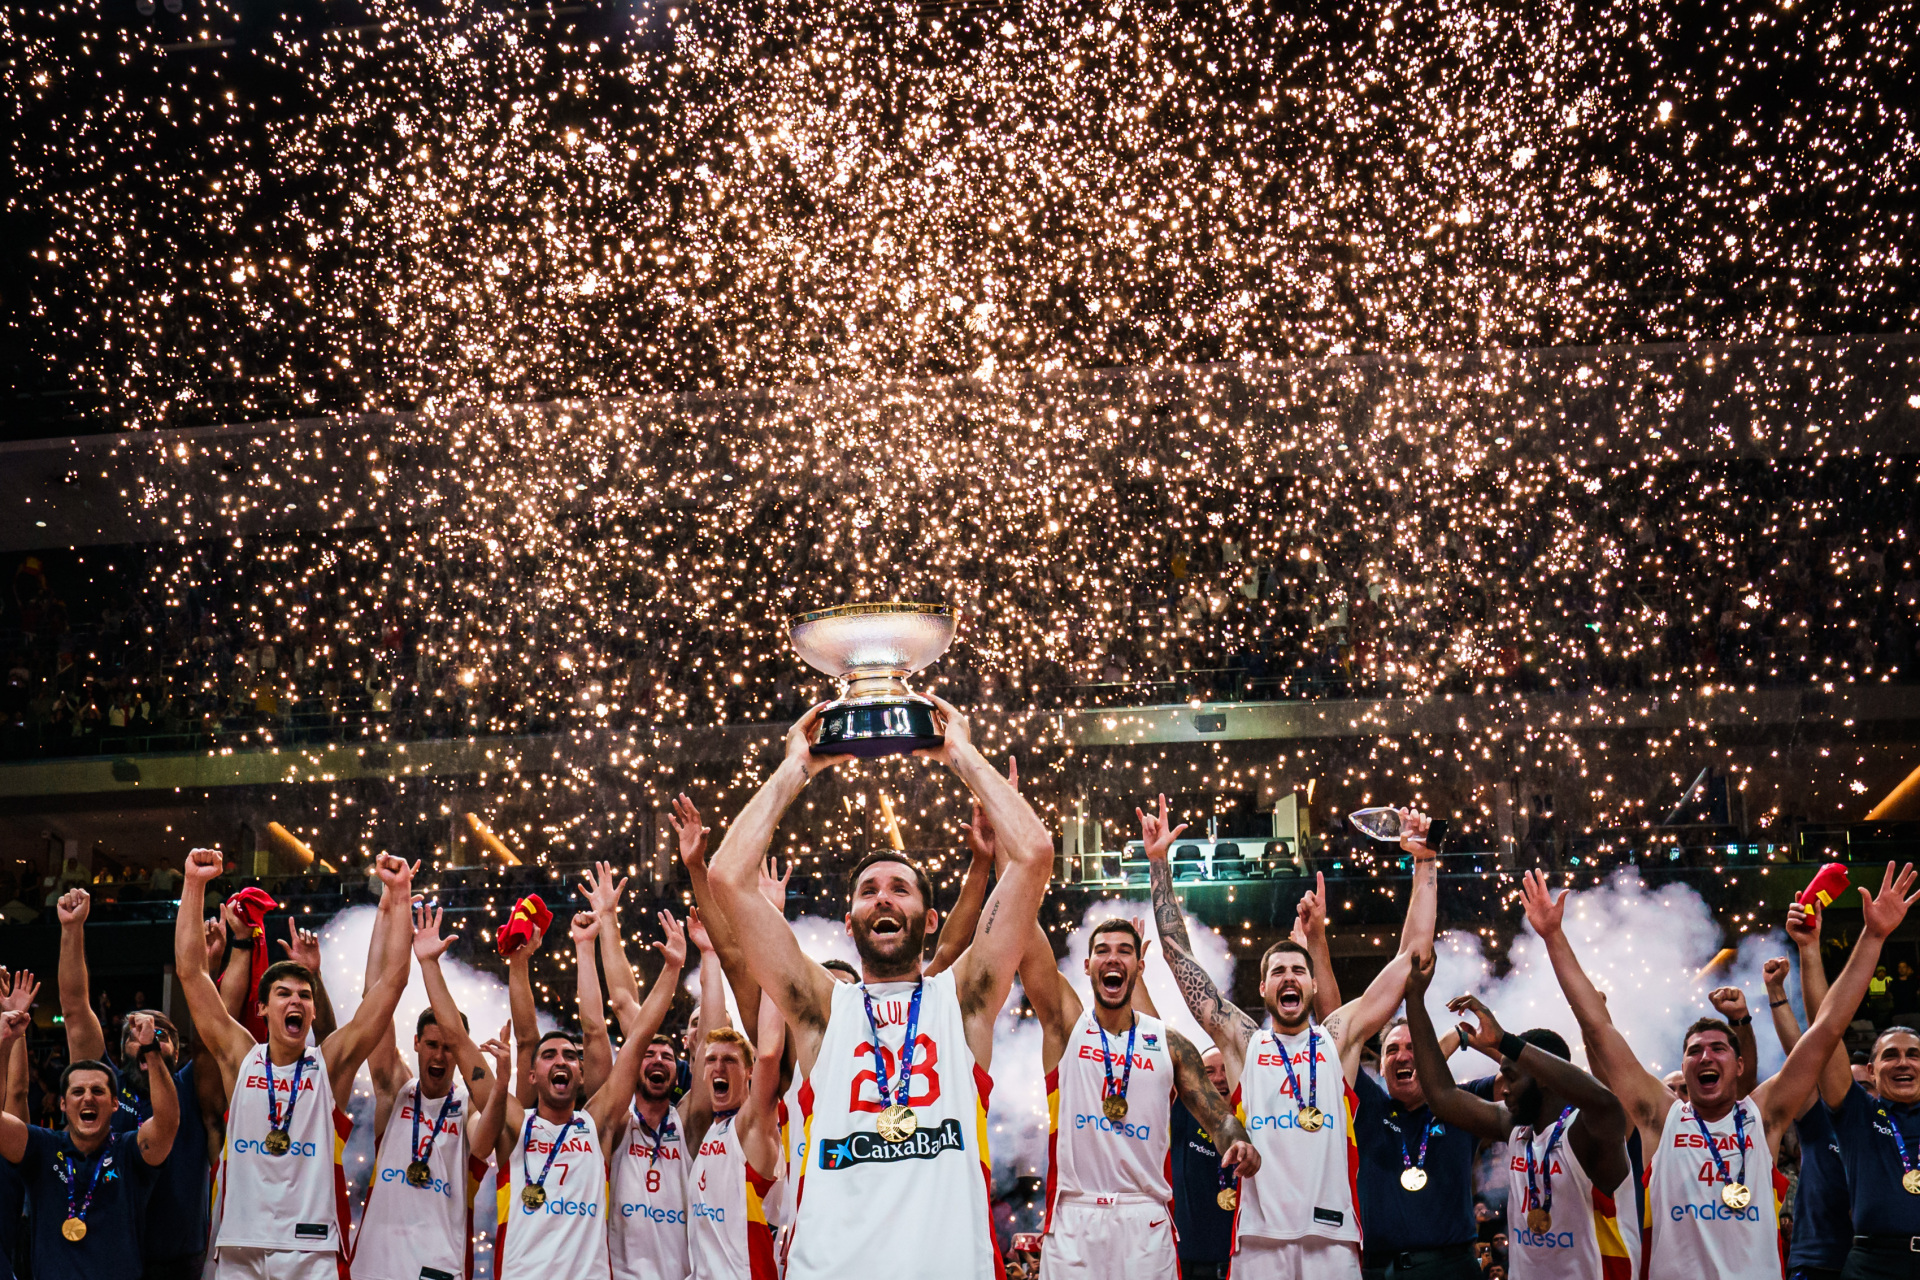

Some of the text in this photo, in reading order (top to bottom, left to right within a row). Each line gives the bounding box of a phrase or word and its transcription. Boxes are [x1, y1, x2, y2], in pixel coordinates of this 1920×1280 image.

[875, 1001, 911, 1029] LUL
[849, 1033, 941, 1113] 23
[1251, 1109, 1333, 1131] enda
[234, 1139, 316, 1157] ensa
[629, 1143, 681, 1160] ESPÑA
[851, 1123, 960, 1159] CaixaBank
[554, 1163, 570, 1186] 7
[646, 1169, 661, 1193] 8
[1513, 1228, 1575, 1248] ndesa
